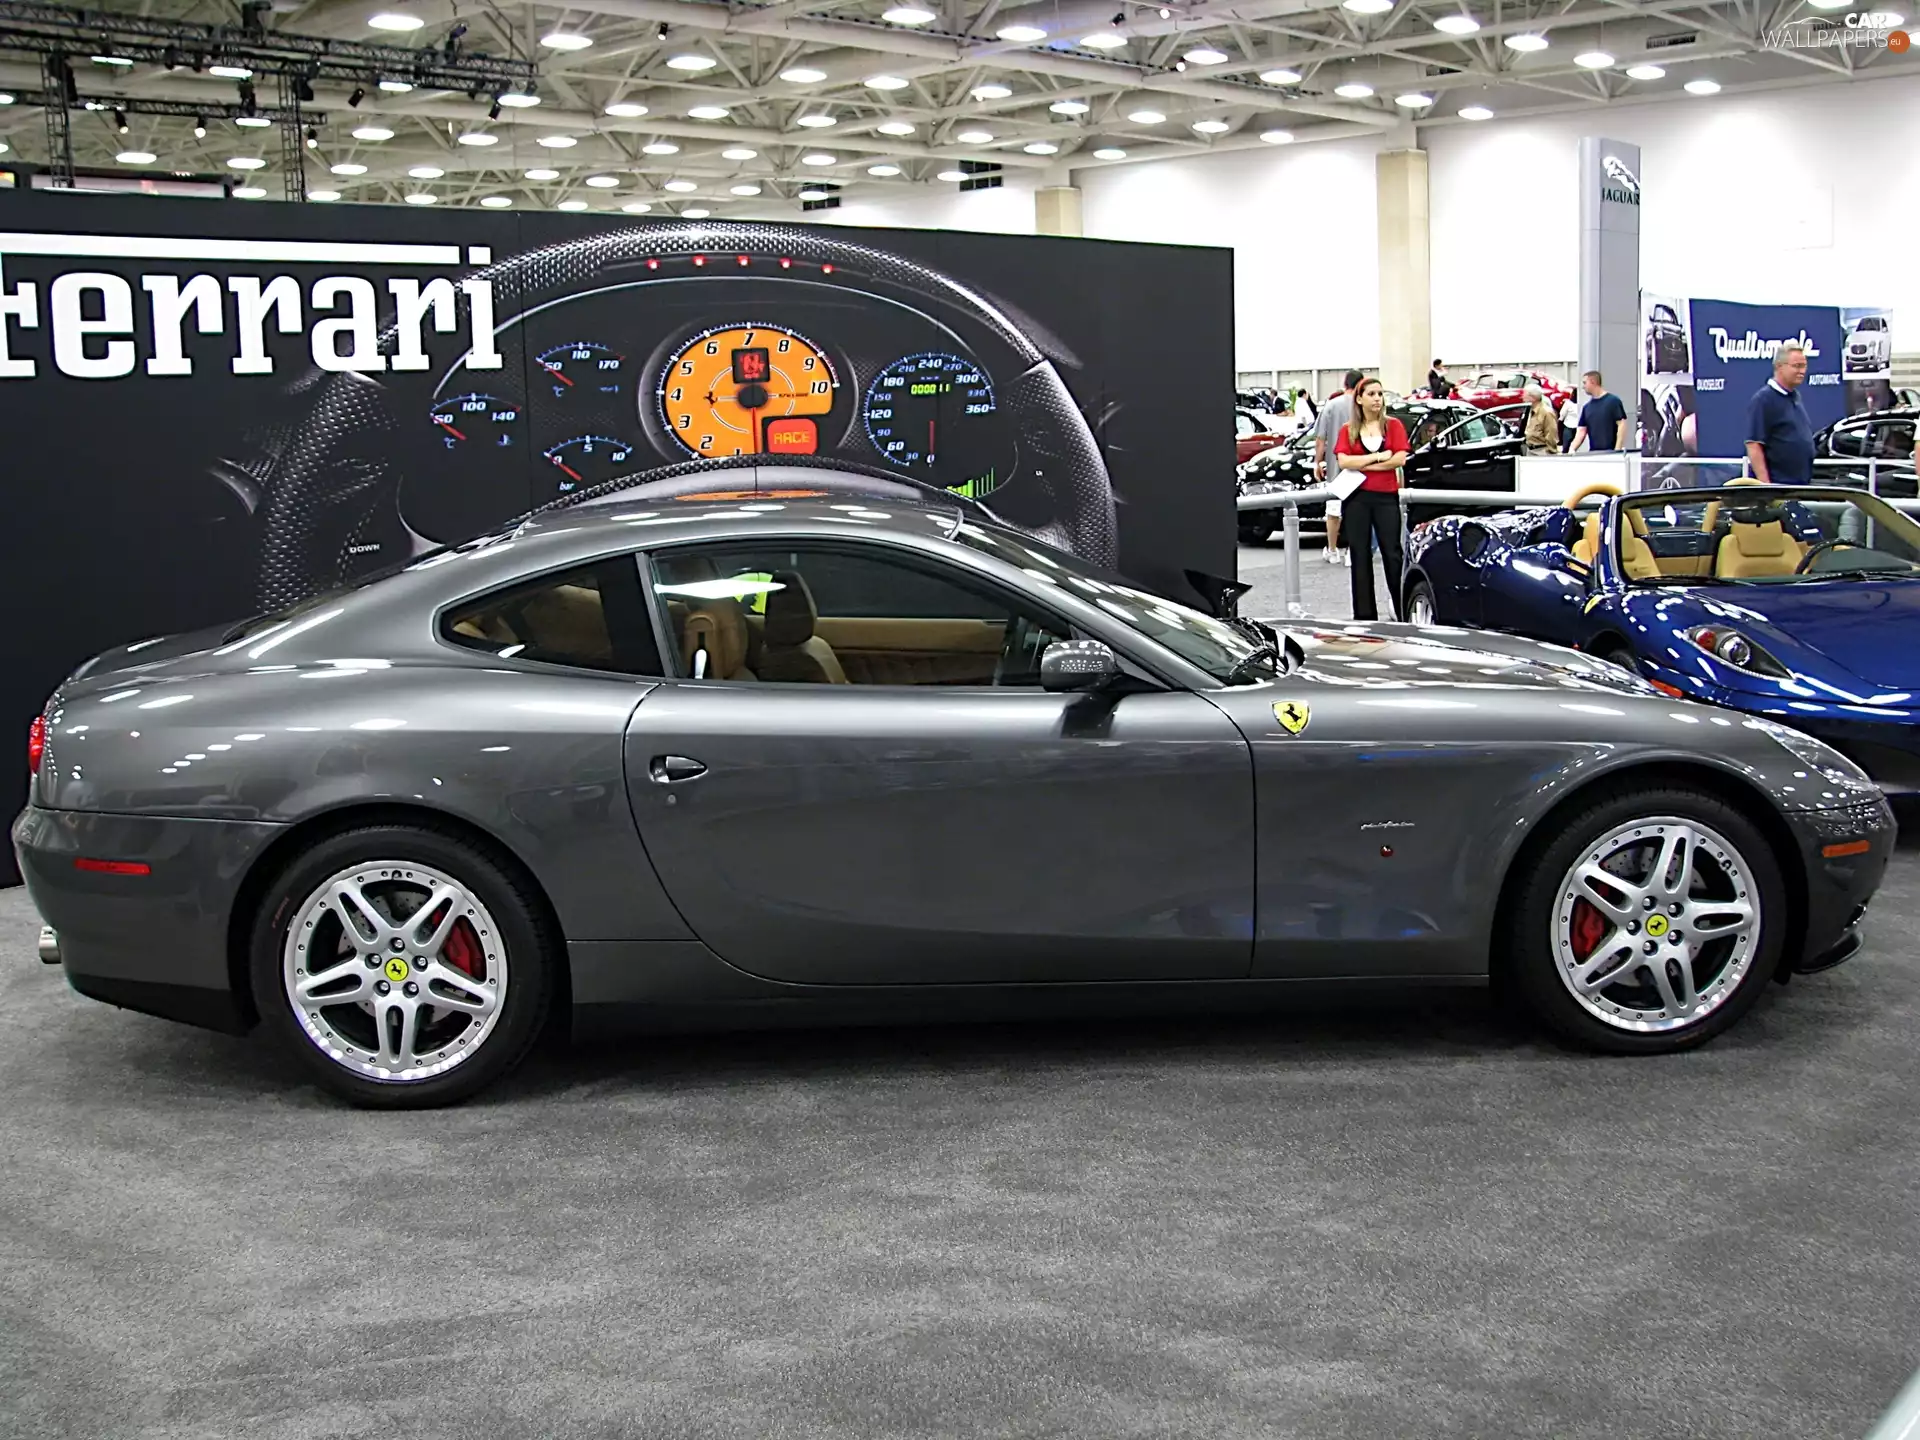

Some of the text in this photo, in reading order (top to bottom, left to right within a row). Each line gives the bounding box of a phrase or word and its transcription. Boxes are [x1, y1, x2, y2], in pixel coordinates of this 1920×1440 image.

[1602, 187, 1640, 205] JAGUAR
[744, 332, 754, 346] 7
[706, 341, 718, 354] 6
[778, 340, 790, 353] 8
[572, 350, 590, 359] 110
[599, 360, 619, 369] 170
[681, 361, 693, 375] 5
[804, 358, 815, 371] 9
[918, 358, 942, 369] 240
[943, 363, 962, 371] 270
[899, 365, 915, 373] 210
[883, 376, 904, 387] 180
[955, 374, 979, 384] 300
[811, 381, 828, 394] 10
[671, 388, 681, 401] 4
[874, 393, 892, 401] 150
[462, 402, 487, 411] 100
[965, 404, 990, 414] 360
[492, 411, 516, 421] 140
[870, 409, 892, 419] 120
[679, 415, 690, 429] 3
[583, 443, 593, 453] 5
[701, 436, 713, 450] 2
[887, 441, 905, 451] 60
[612, 452, 625, 462] 10
[350, 543, 380, 553] DOWN
